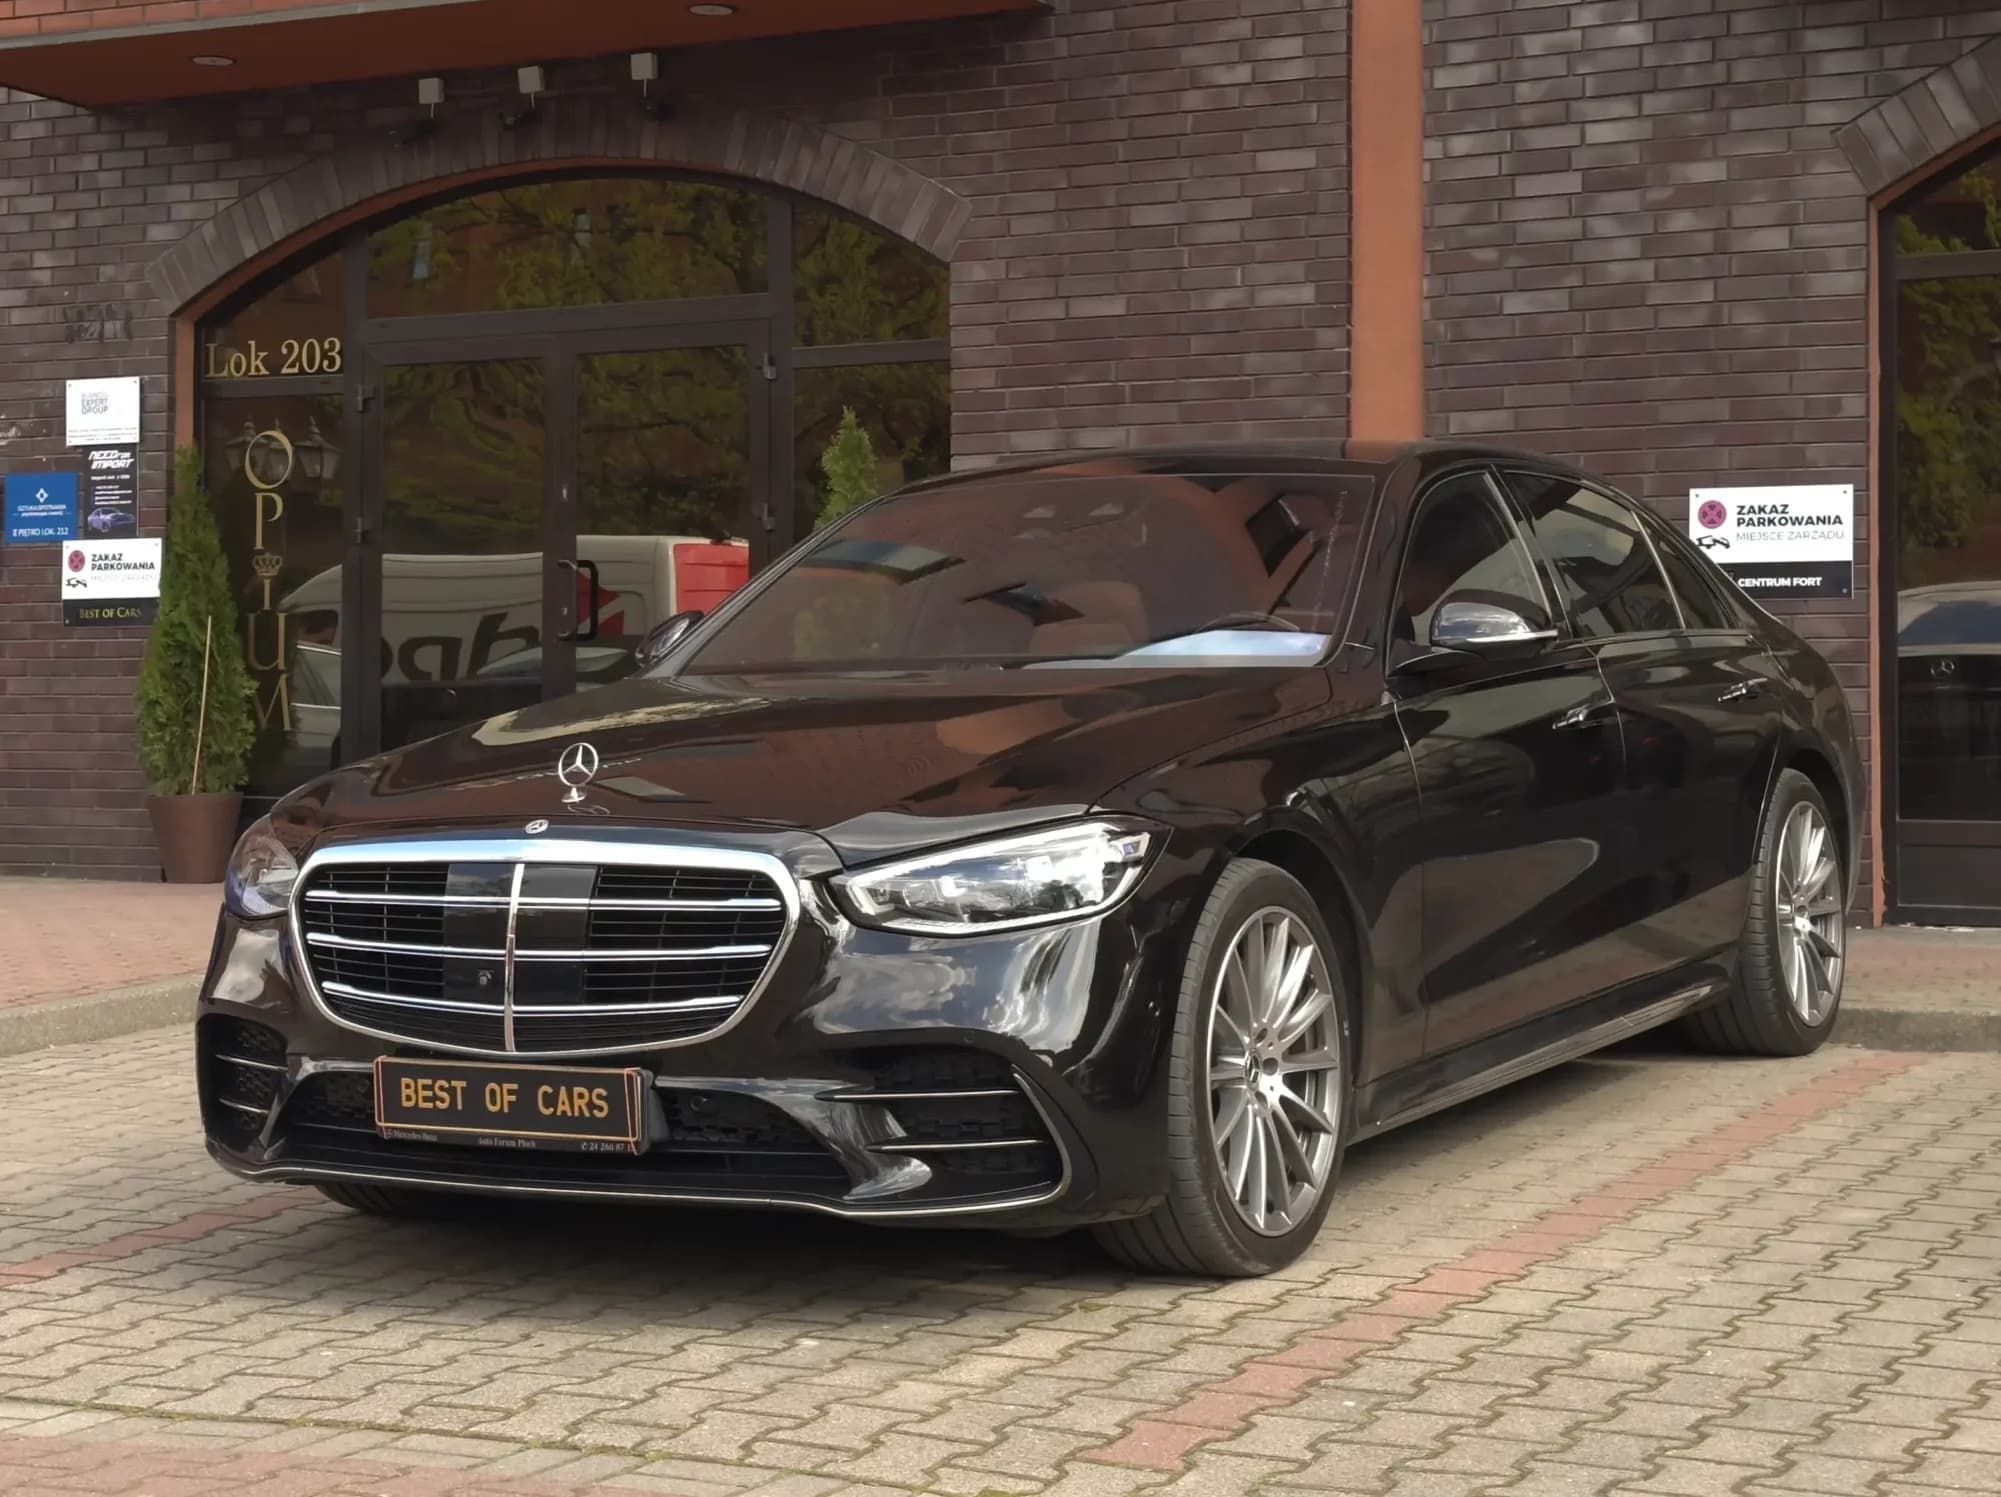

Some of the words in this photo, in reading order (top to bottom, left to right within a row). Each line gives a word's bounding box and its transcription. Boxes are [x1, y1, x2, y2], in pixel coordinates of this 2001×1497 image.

[205, 340, 270, 377] Lok
[280, 337, 342, 374] 203
[1737, 504, 1789, 516] ZAKAZ
[1737, 515, 1843, 527] PARKOWANIA
[57, 527, 69, 536] 212
[1737, 531, 1783, 541] MIEJSCE
[91, 553, 123, 562] ZAKAZ
[91, 562, 155, 571] PARKOWANIA
[1737, 577, 1790, 588] CENTRUM
[1793, 576, 1823, 587] FORT
[401, 1077, 467, 1111] BEST
[485, 1082, 518, 1113] OF
[537, 1085, 608, 1118] CARS
[588, 1142, 599, 1152] 24
